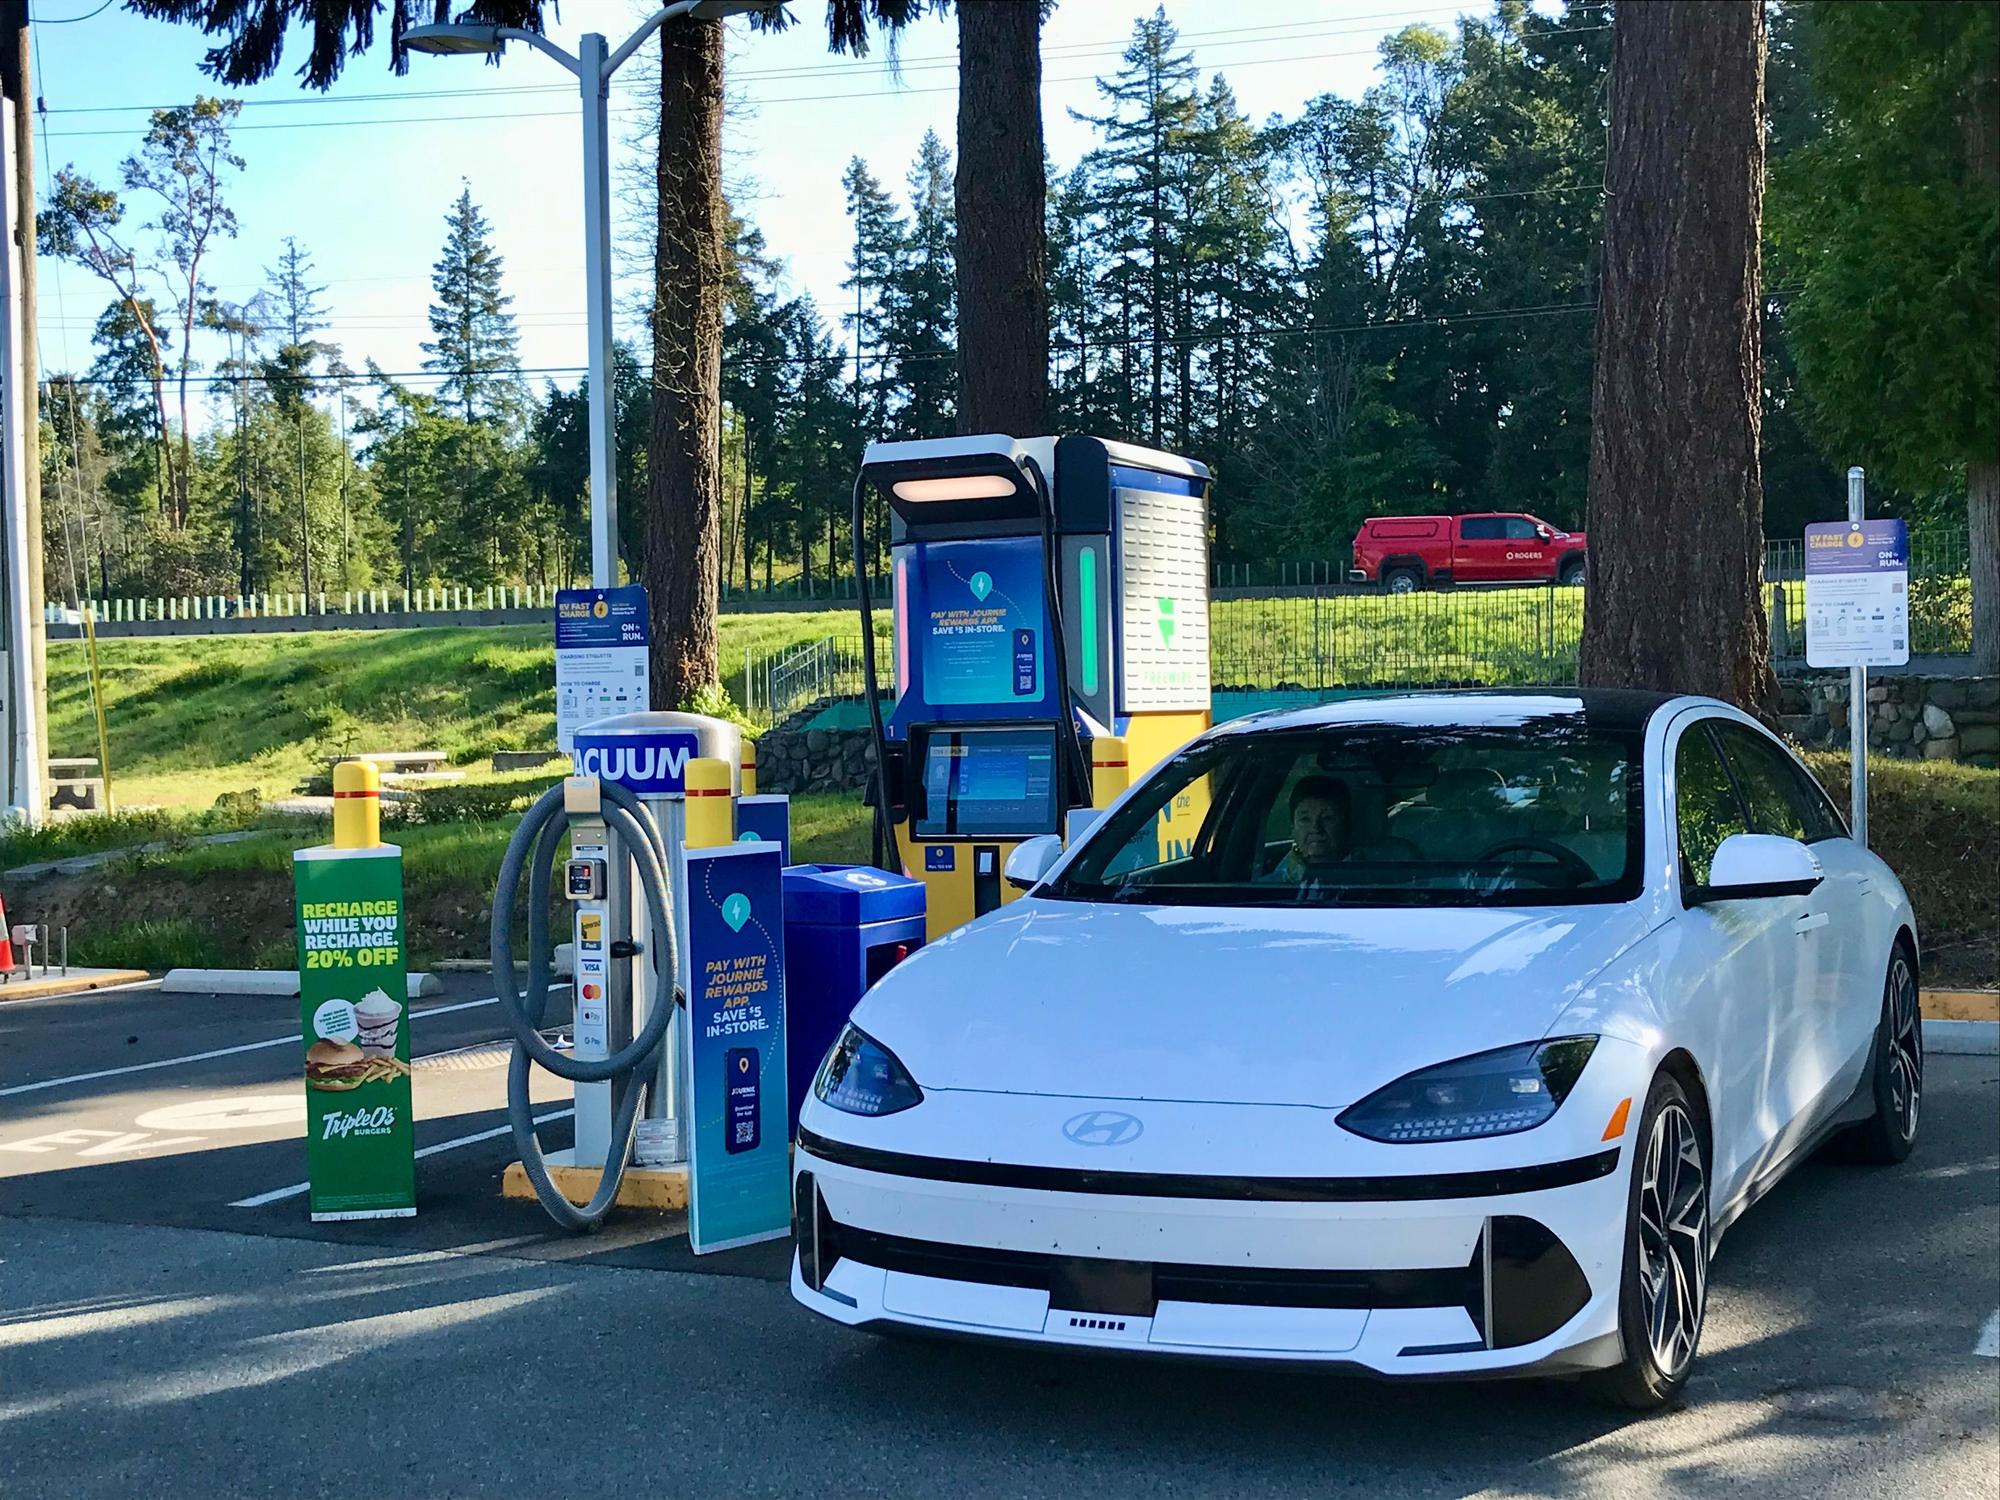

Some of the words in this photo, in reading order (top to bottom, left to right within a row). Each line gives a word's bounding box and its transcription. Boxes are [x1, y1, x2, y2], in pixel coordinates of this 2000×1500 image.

[931, 611, 946, 619] PAY
[932, 626, 954, 635] SAVE
[574, 747, 690, 780] ACUUM
[302, 900, 398, 918] RECHARGE
[304, 917, 359, 933] WHILE
[362, 916, 398, 931] YOU
[305, 931, 398, 949] RECHARGE.
[306, 949, 353, 968] 20%
[357, 947, 398, 966] OFF
[706, 960, 730, 973] PAY
[733, 954, 766, 969] WITH
[709, 968, 764, 985] JOURNIE
[705, 980, 768, 999] REWARDS
[591, 1012, 600, 1022] Pay
[713, 1008, 746, 1024] SAVE
[750, 1006, 761, 1018] $5
[706, 1018, 769, 1037] IN-STORE.
[591, 1037, 600, 1046] Pay
[354, 1127, 391, 1136] BURGERS
